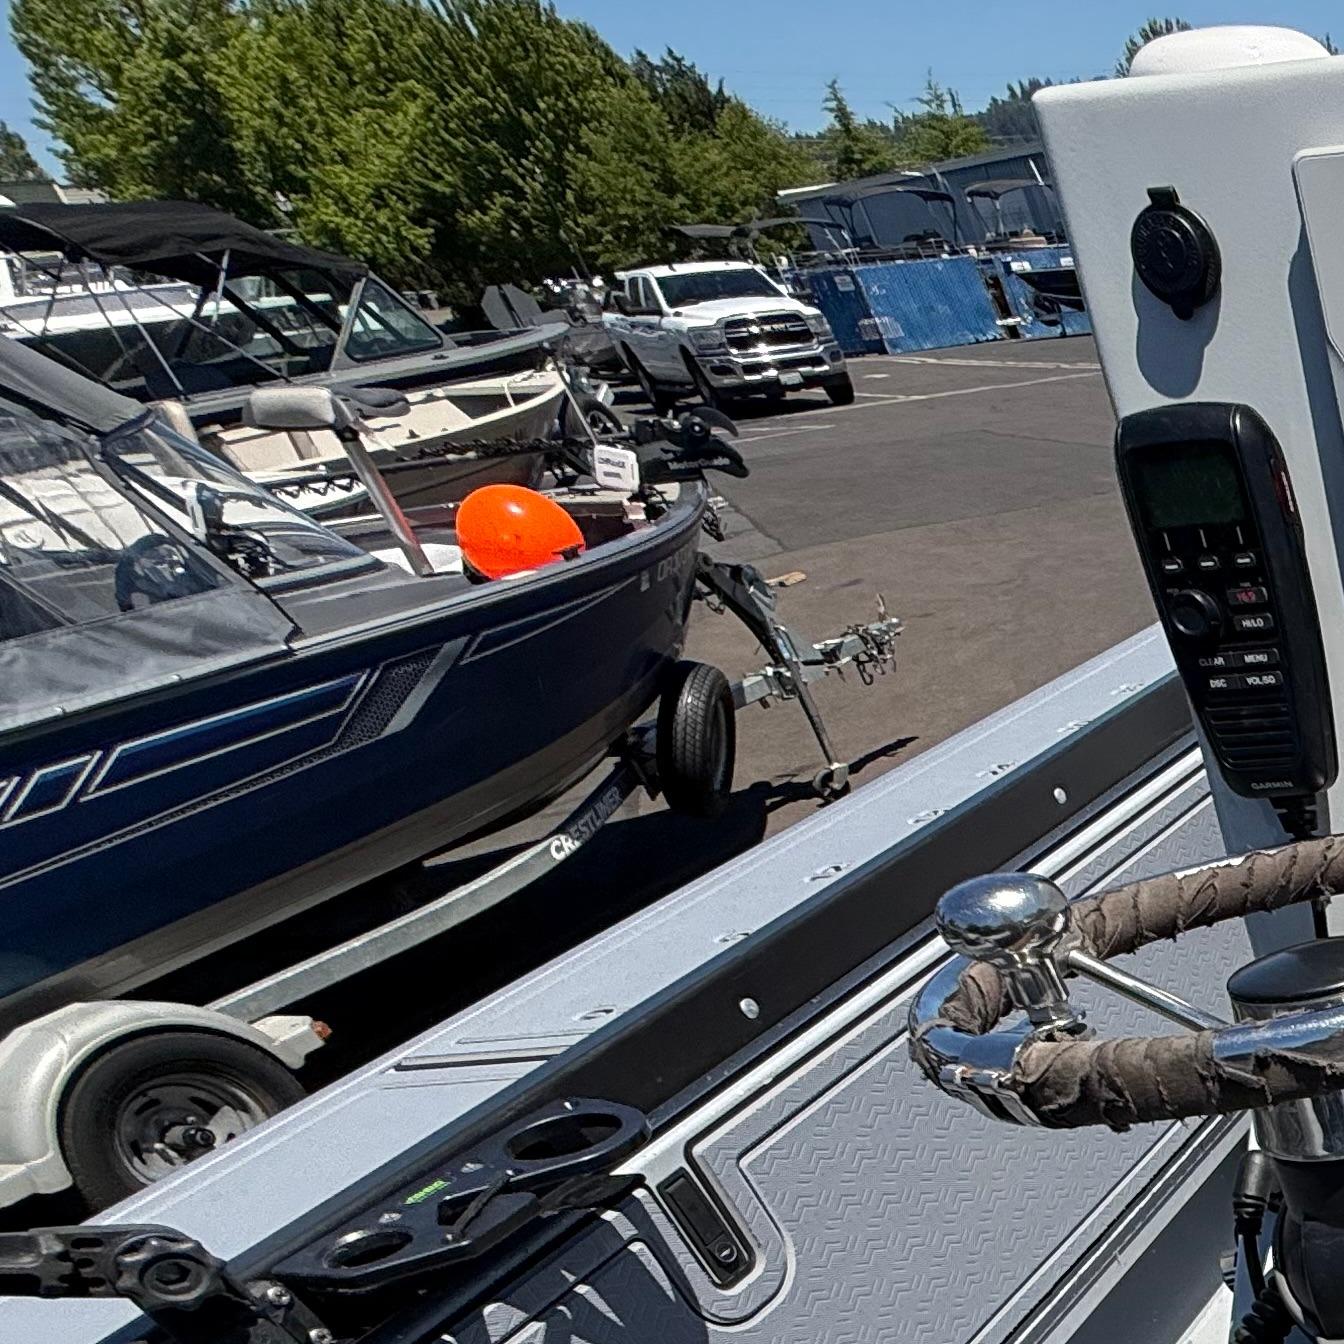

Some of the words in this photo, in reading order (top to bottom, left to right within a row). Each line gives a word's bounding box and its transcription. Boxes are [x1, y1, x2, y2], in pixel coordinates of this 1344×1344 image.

[1244, 653, 1268, 664] MENU
[1250, 781, 1294, 790] GARMIN
[550, 785, 623, 861] CRESTLINER
